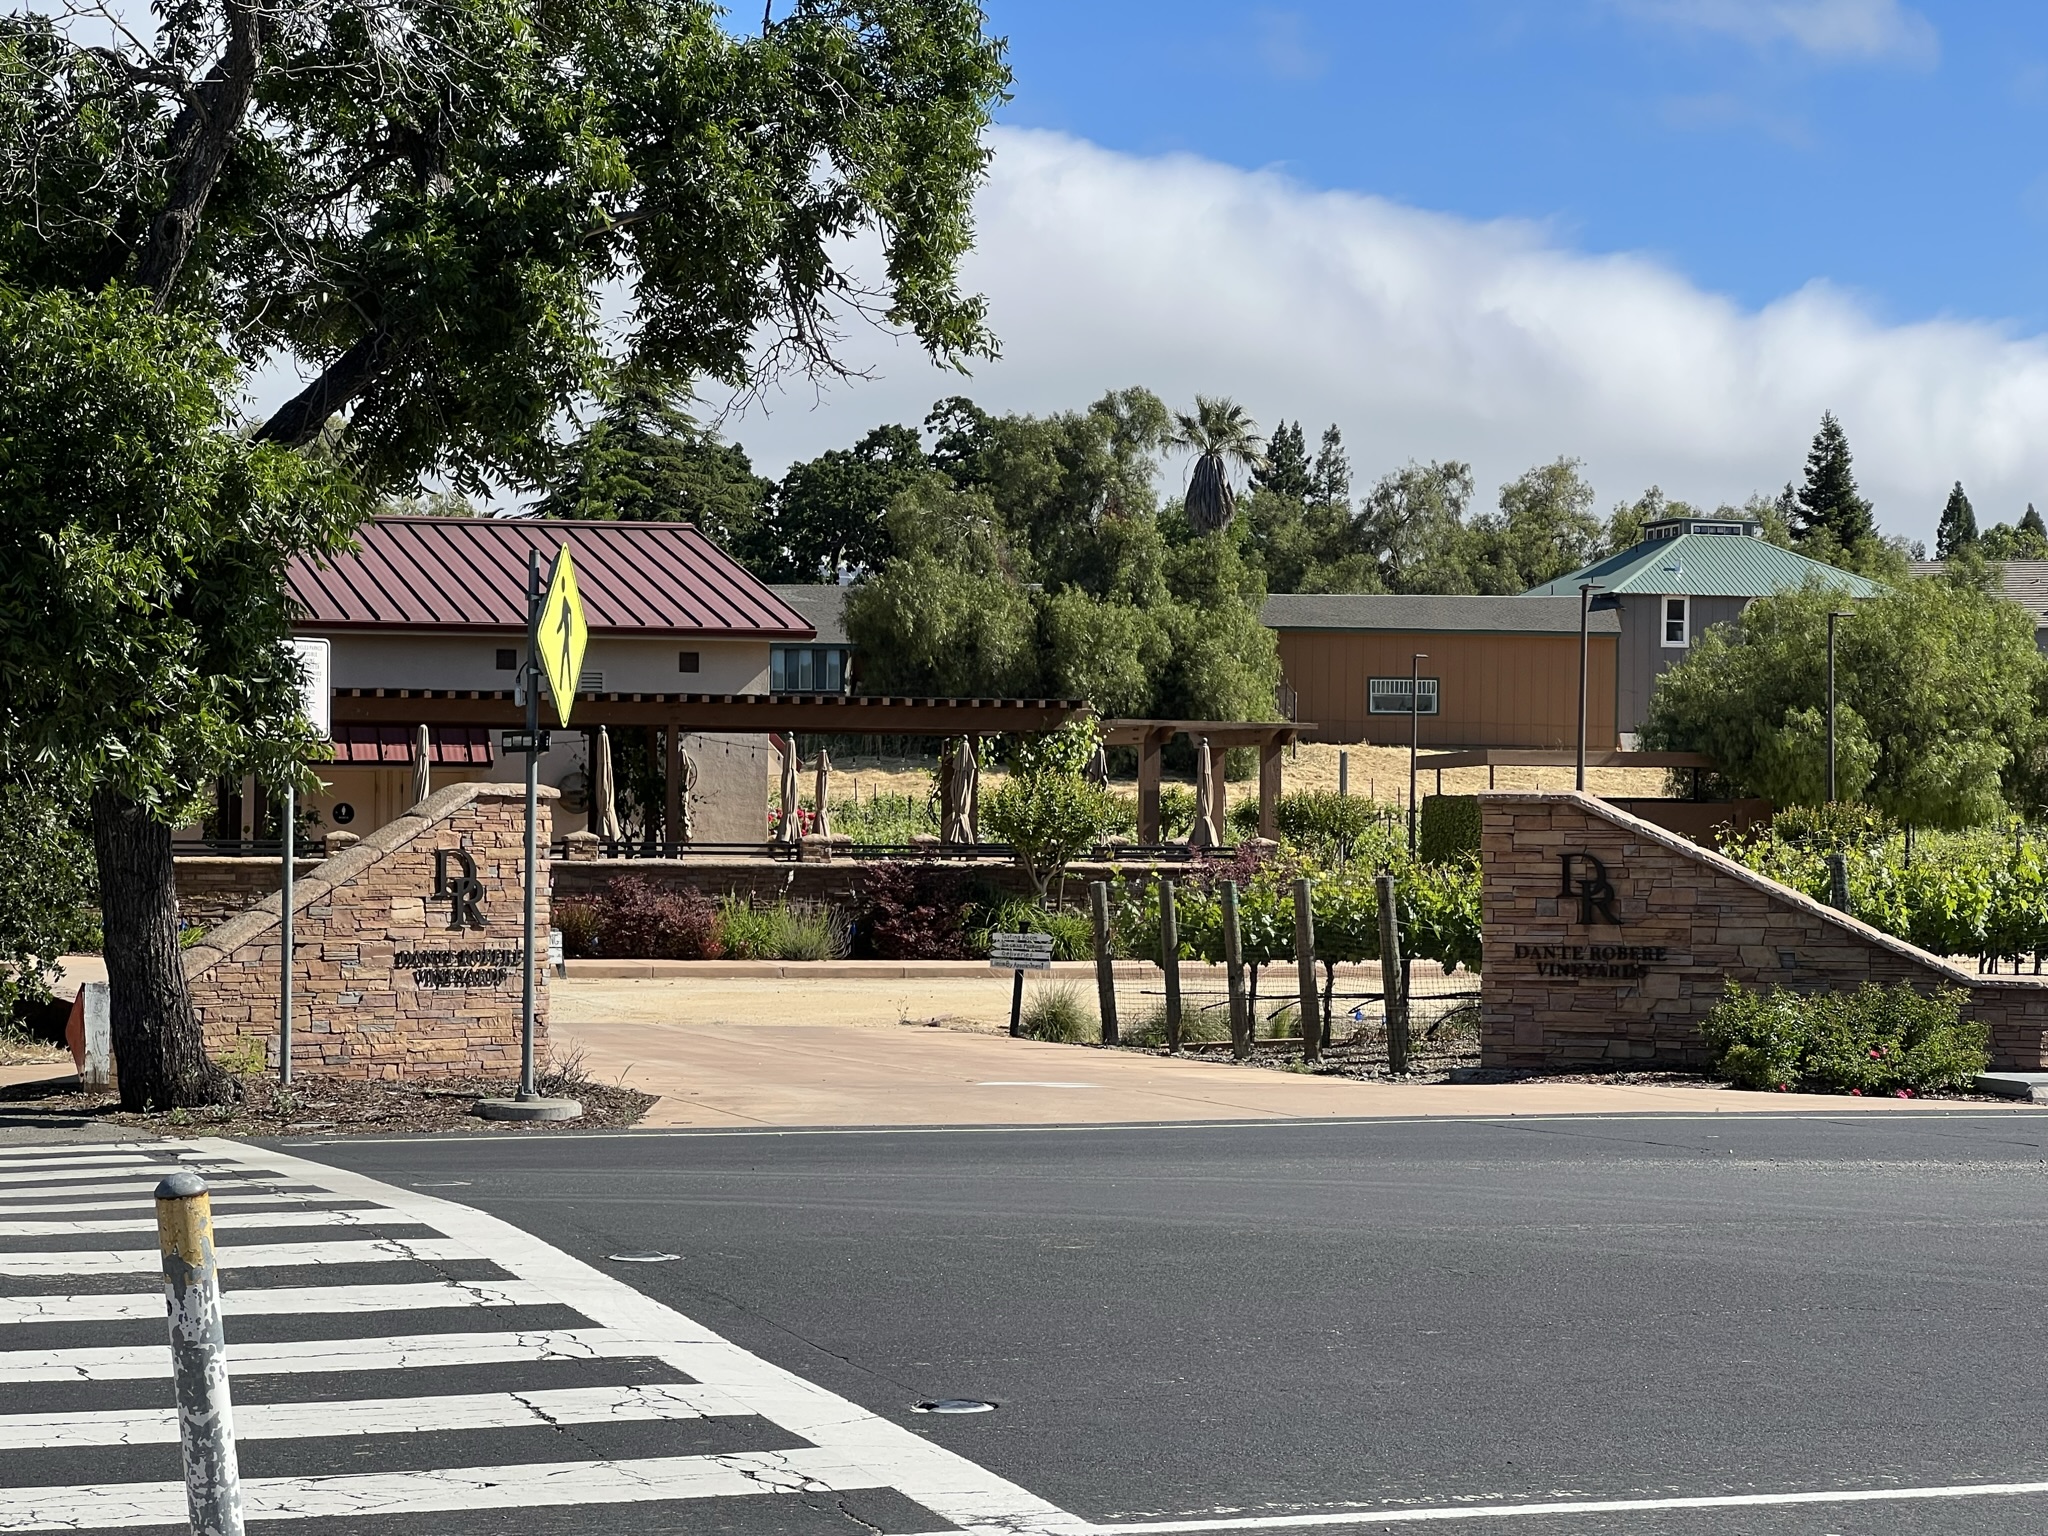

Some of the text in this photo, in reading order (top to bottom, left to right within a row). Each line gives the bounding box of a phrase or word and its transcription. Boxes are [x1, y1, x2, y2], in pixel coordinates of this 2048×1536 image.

[1515, 945, 1668, 961] DANTE ROBERE
[412, 968, 508, 987] VINEYARDS
[1536, 962, 1650, 979] VINEYARDS
